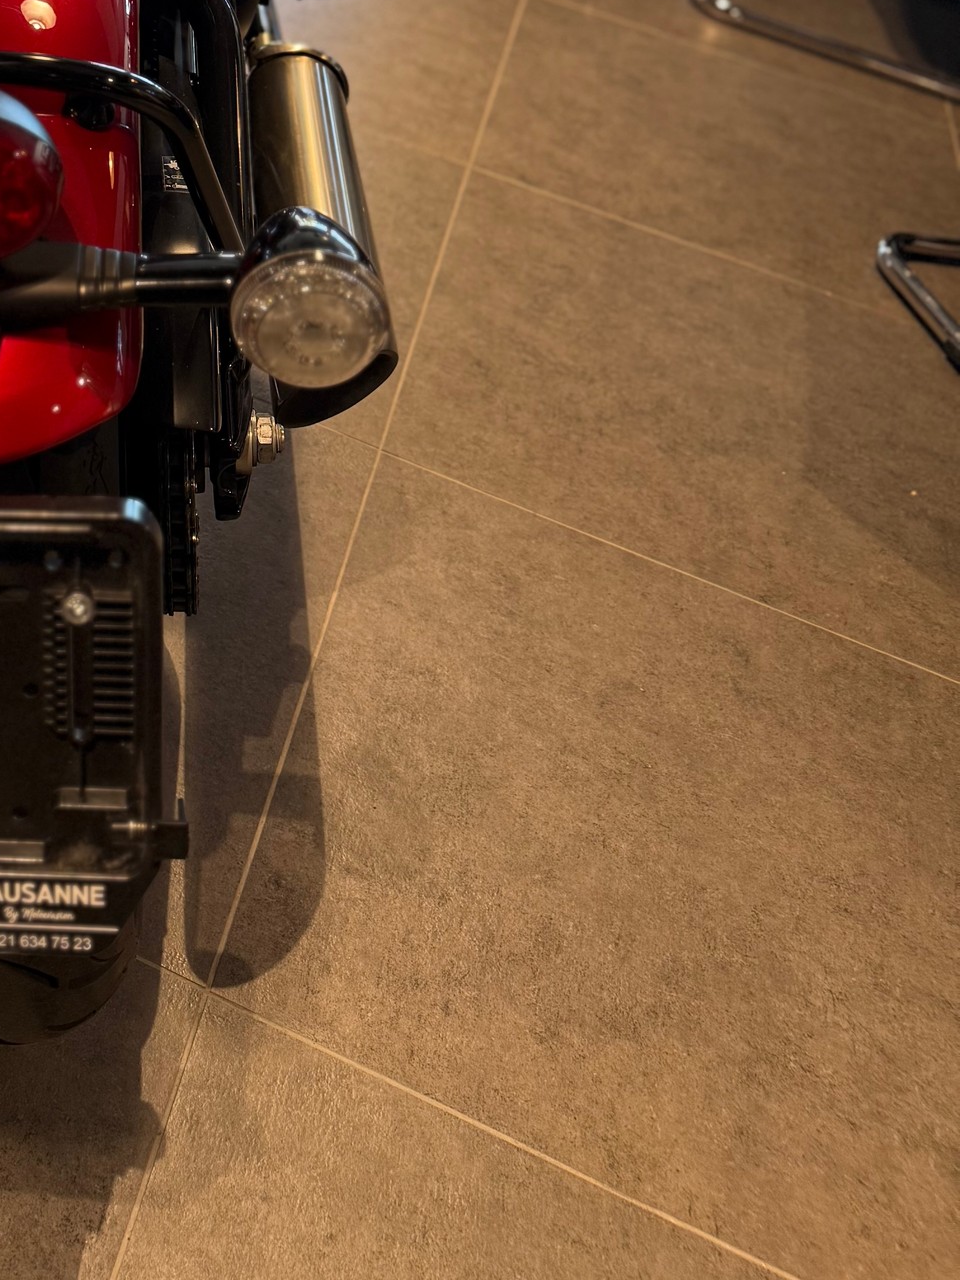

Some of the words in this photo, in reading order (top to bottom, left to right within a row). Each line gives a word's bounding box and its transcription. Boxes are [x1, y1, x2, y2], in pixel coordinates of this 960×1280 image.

[19, 935, 47, 948] 634
[51, 936, 70, 949] 75
[73, 937, 93, 950] 23
